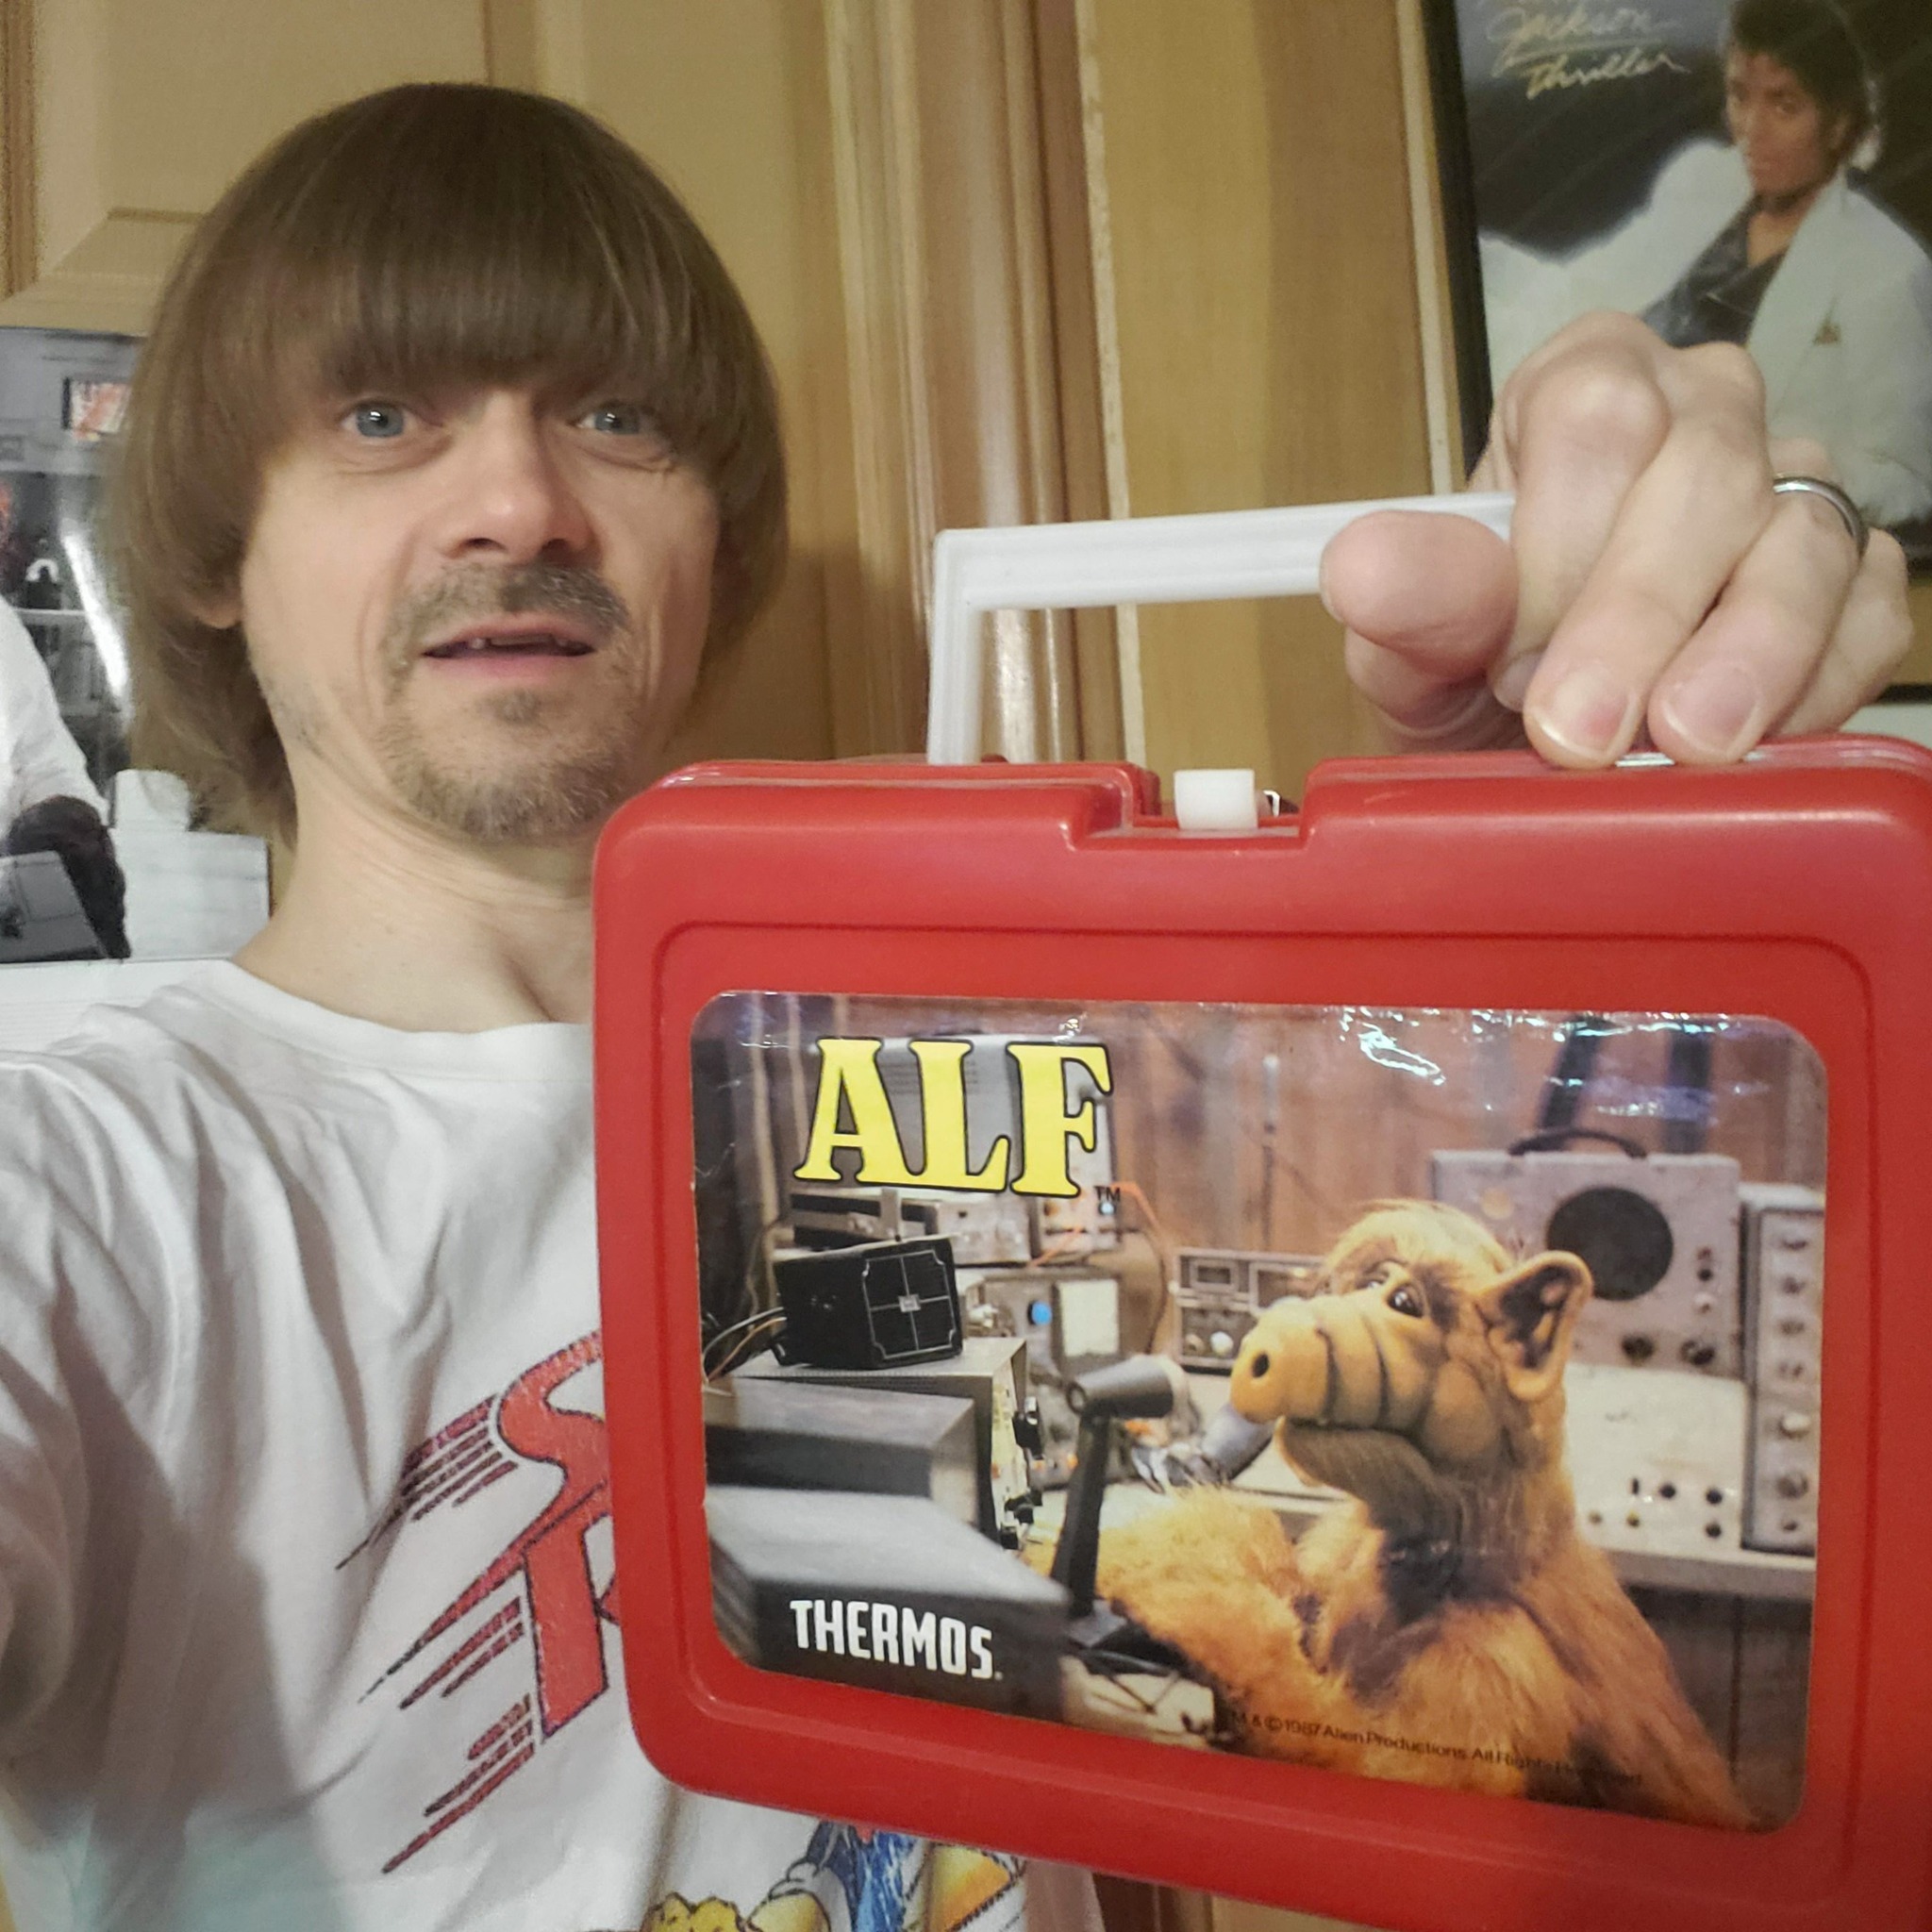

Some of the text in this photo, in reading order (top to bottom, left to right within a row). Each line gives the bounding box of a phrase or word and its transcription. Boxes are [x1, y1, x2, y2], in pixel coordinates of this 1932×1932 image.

[1524, 47, 1691, 99] Thriller
[793, 1036, 1114, 1197] ALF
[1093, 1185, 1121, 1202] TM
